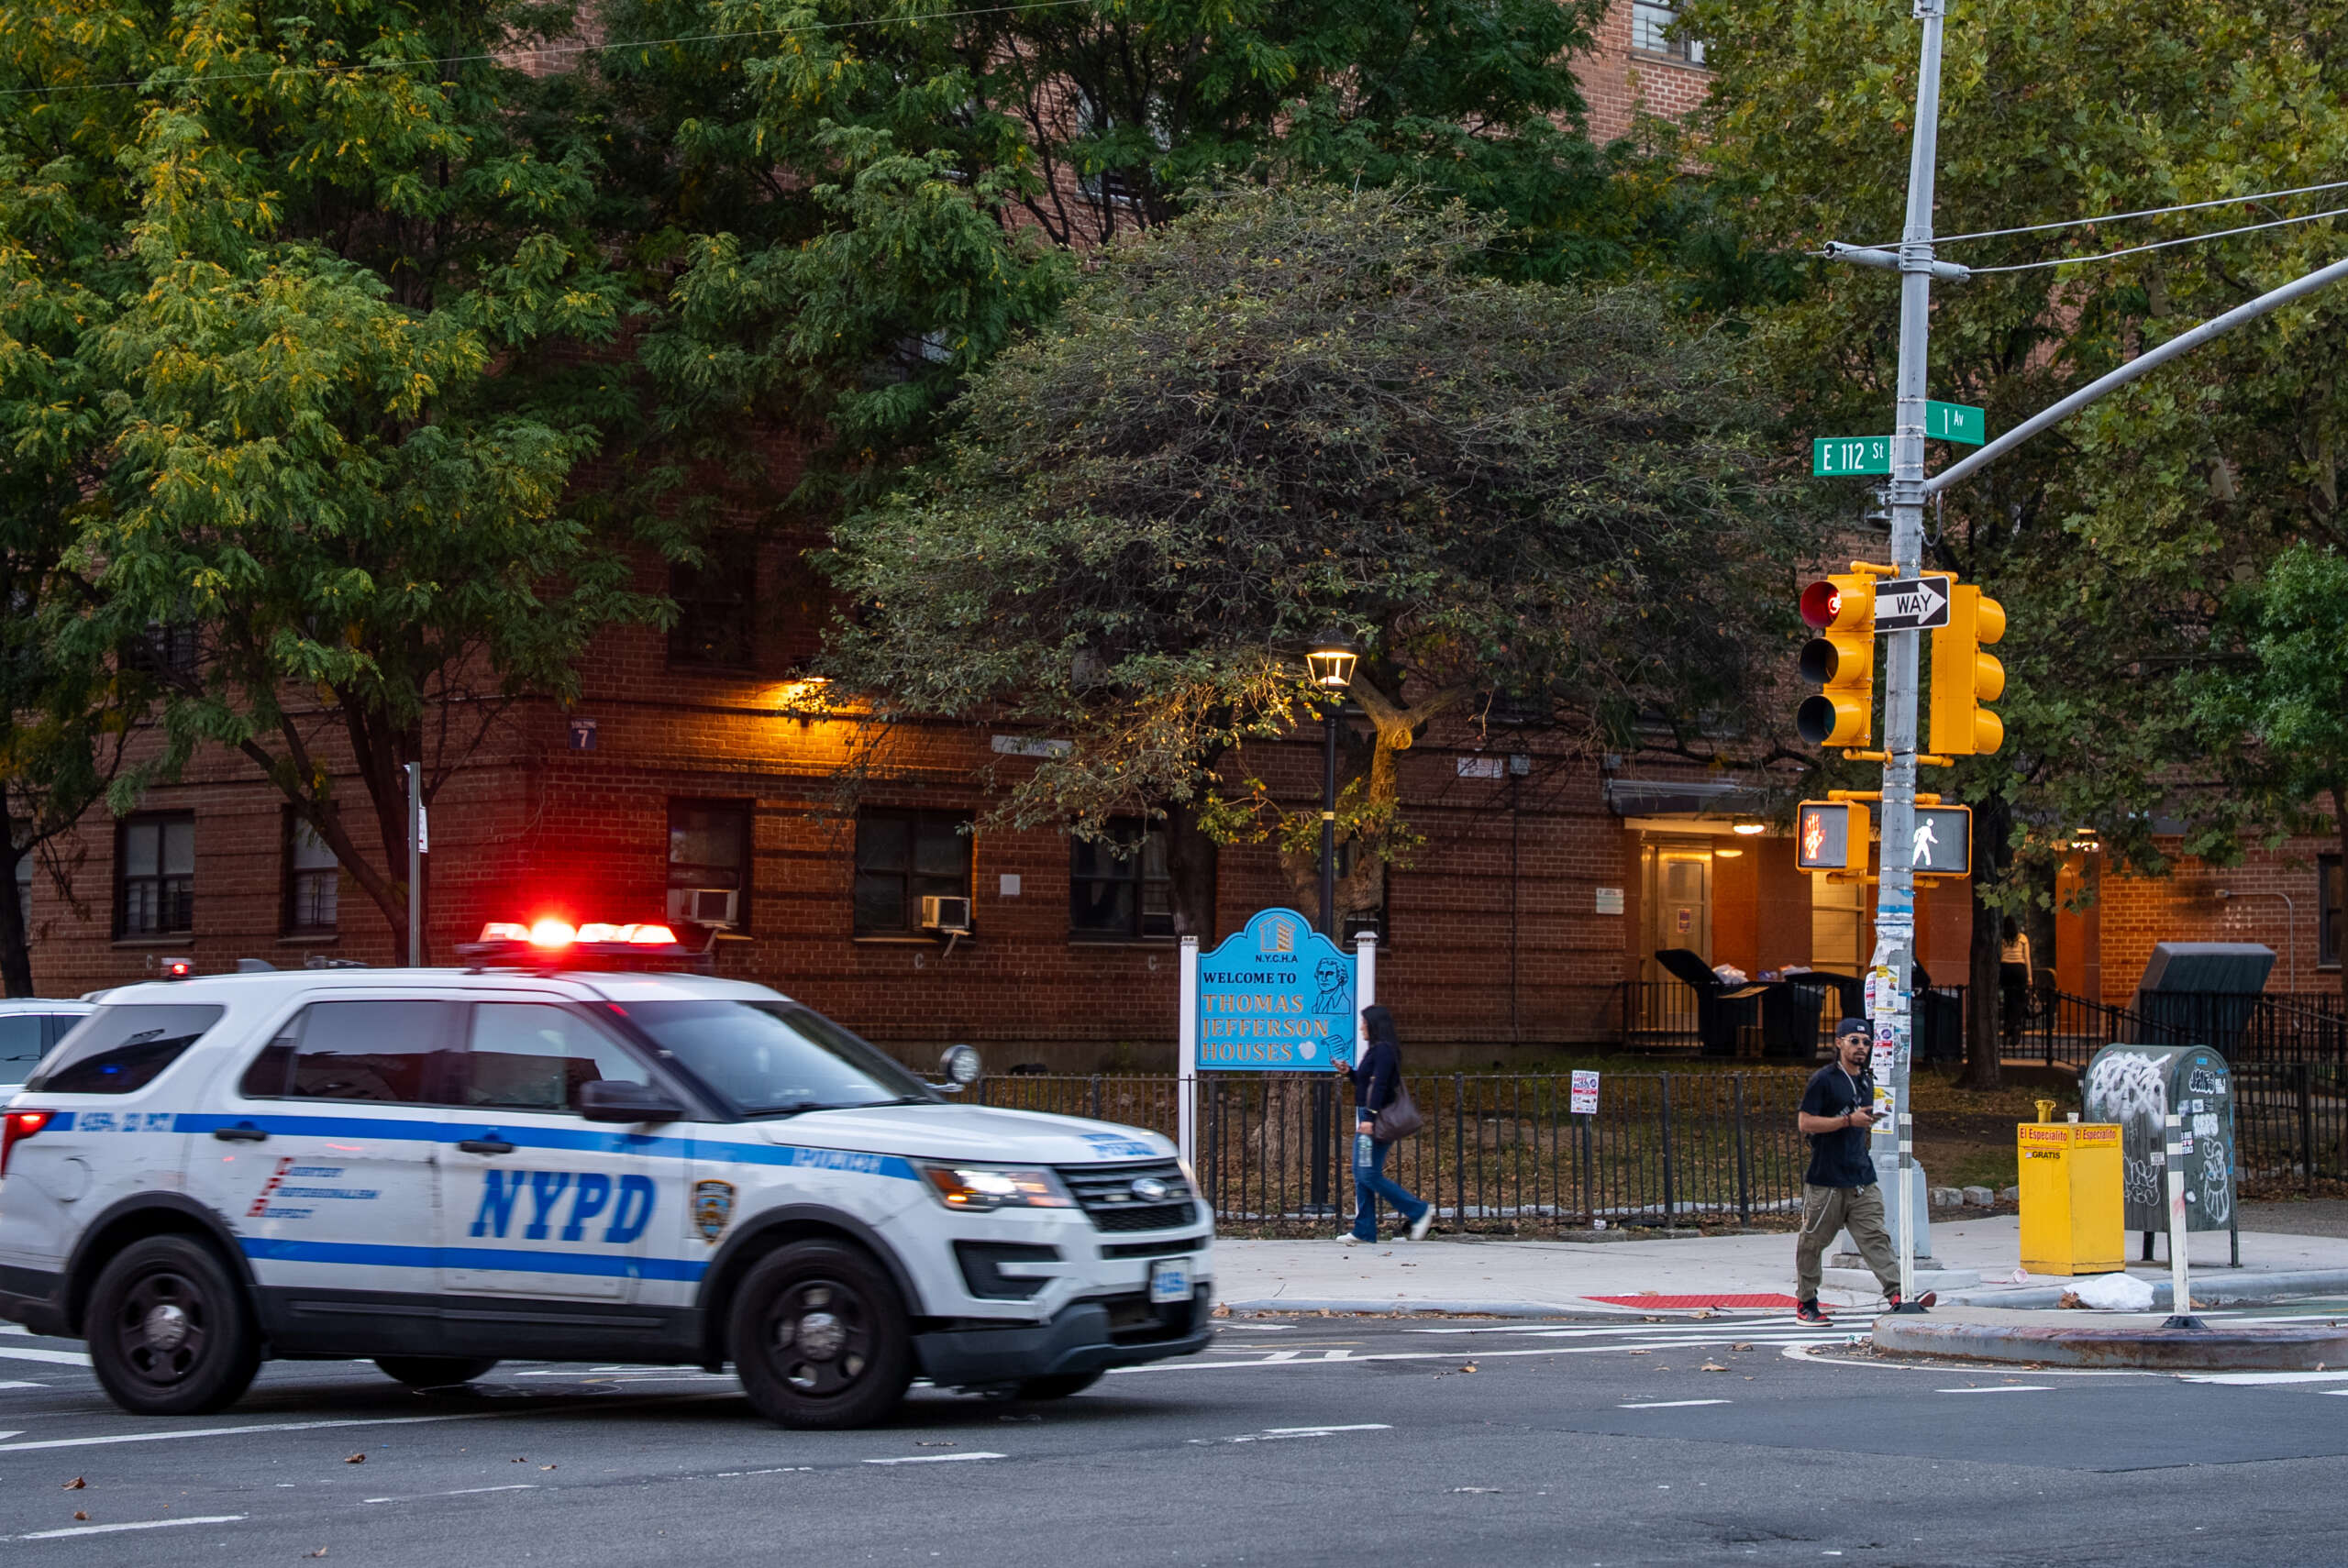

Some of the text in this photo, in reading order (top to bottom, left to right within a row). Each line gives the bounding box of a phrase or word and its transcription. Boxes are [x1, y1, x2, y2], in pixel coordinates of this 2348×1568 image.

[1944, 409, 1964, 435] 1 Av
[1823, 442, 1884, 470] E 112 St
[1897, 593, 1933, 613] WAY
[578, 729, 589, 748] 7
[1203, 972, 1297, 984] WELCOME TO
[1202, 994, 1303, 1012] THOMAS
[1202, 1019, 1328, 1039] JEFFERSON
[1202, 1043, 1292, 1061] HOUSES
[2020, 1128, 2067, 1142] El Especialito
[2076, 1129, 2116, 1140] El Especialito
[2032, 1151, 2061, 1159] GRATIS
[469, 1169, 657, 1243] NYPD
